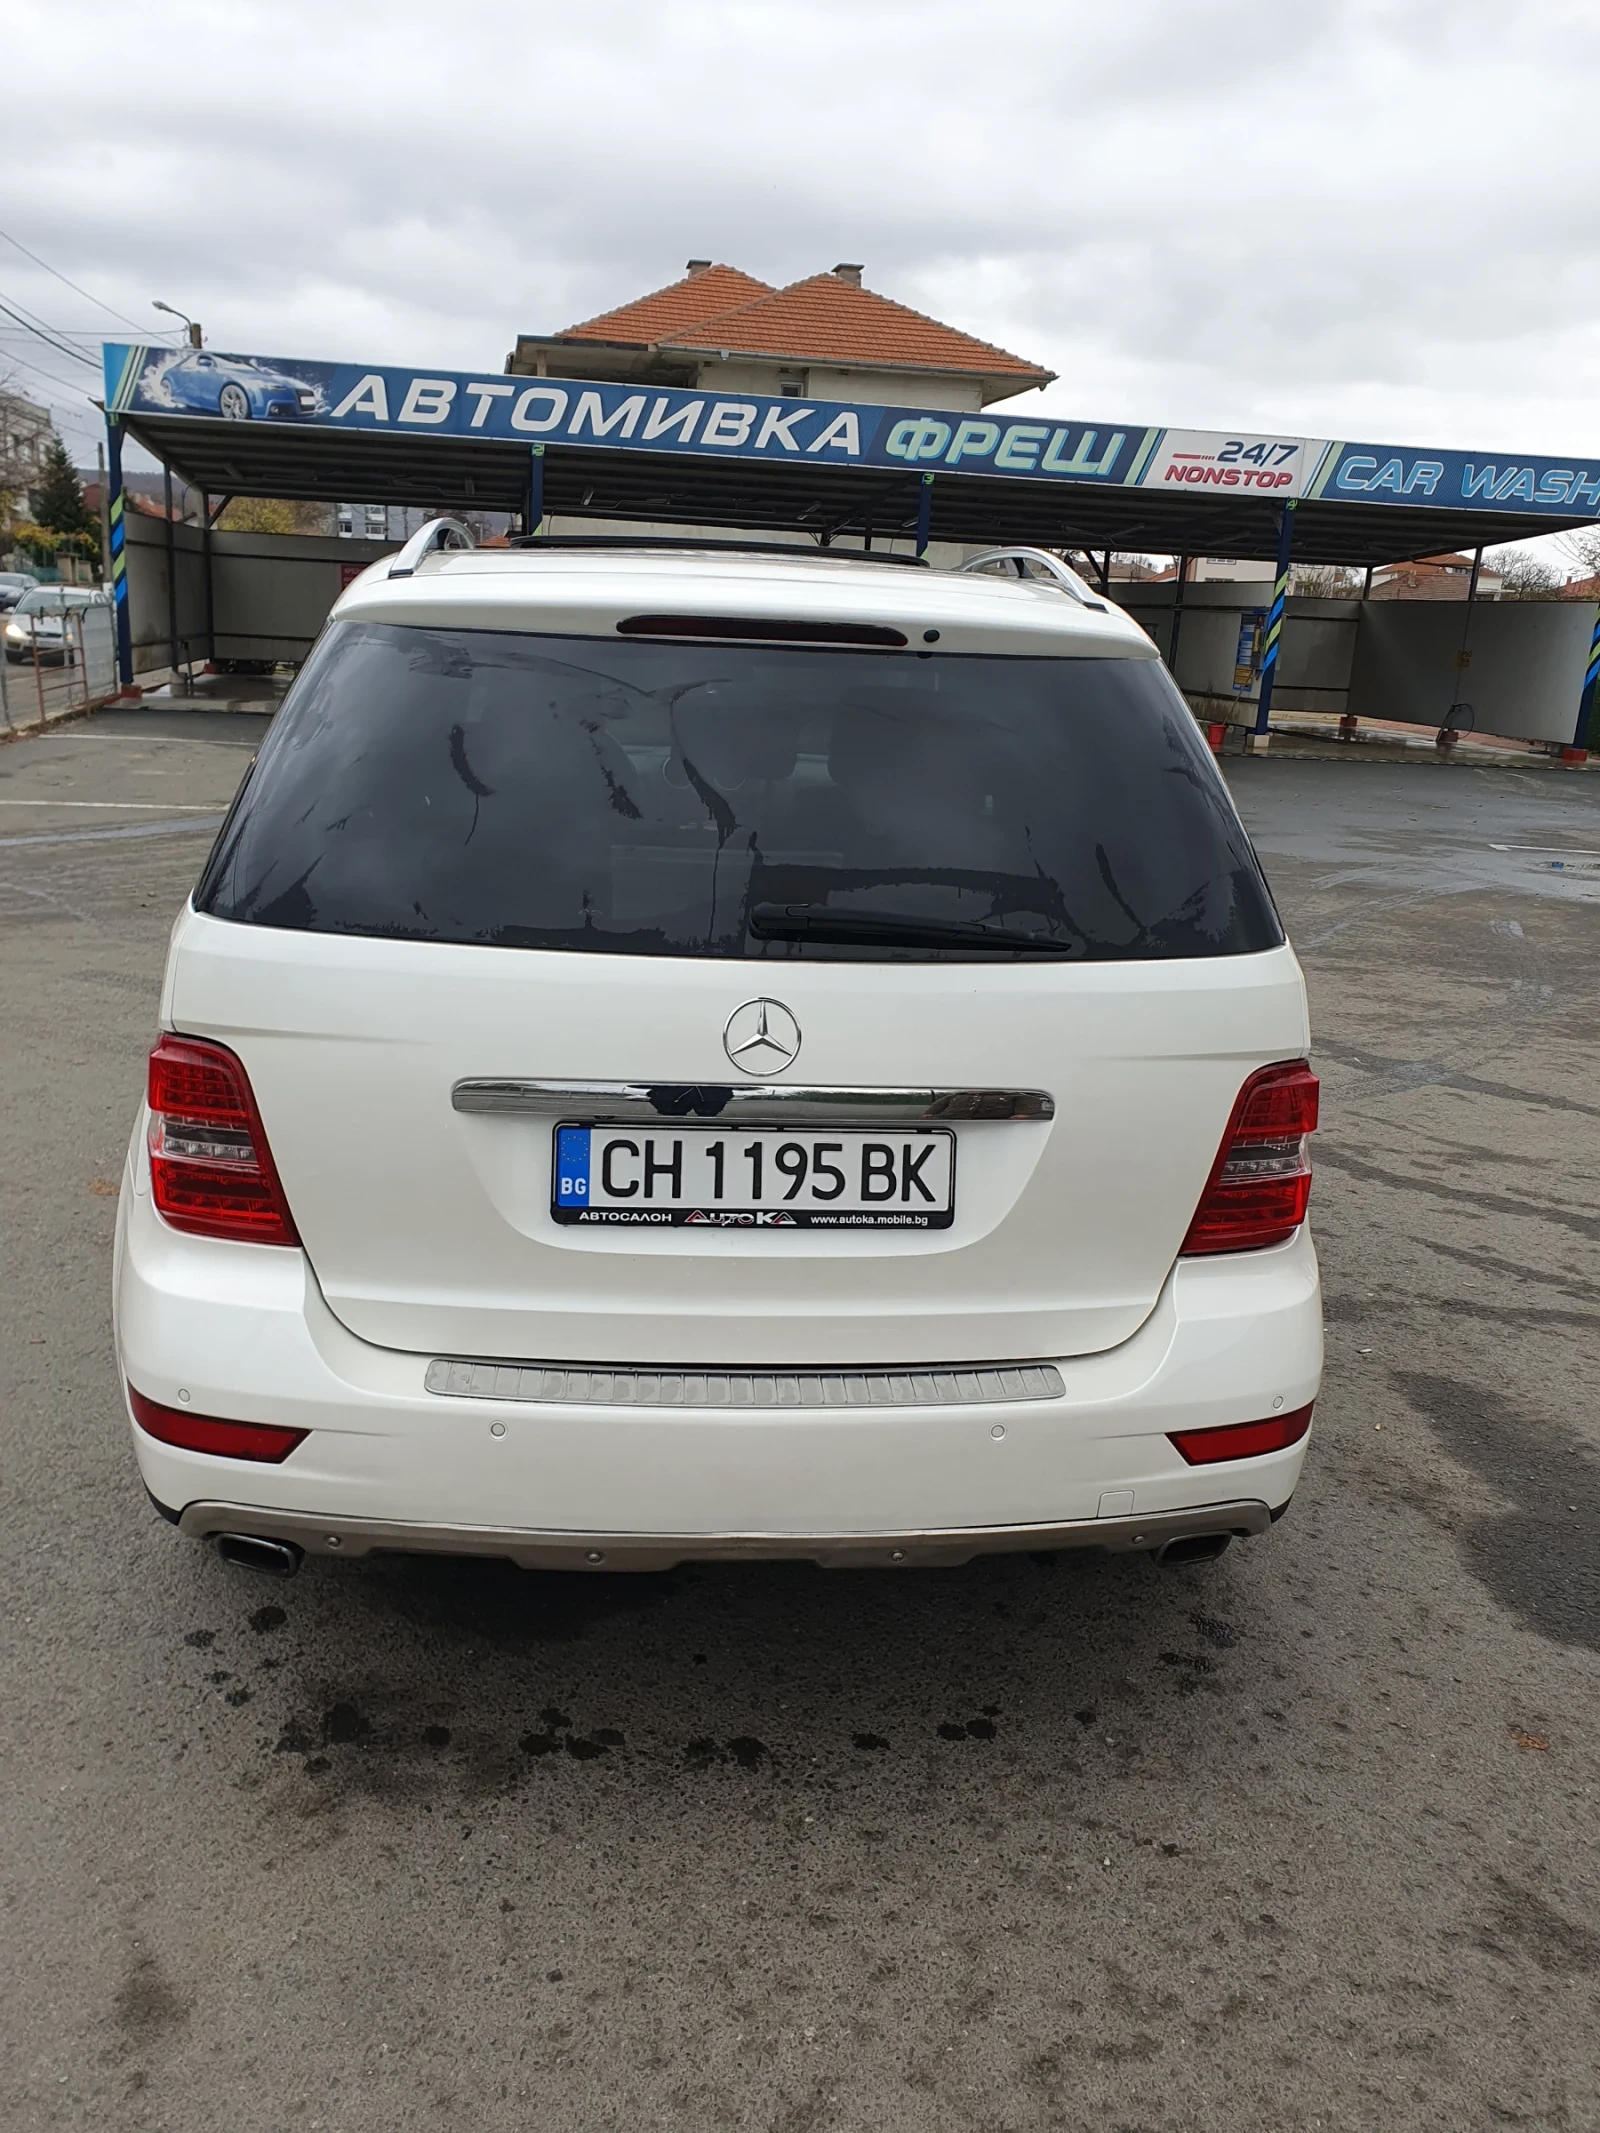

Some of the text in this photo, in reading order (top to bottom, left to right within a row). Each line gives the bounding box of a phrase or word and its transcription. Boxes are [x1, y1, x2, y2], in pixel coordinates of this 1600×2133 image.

[330, 374, 1127, 476] АВТОМИВКА ФРЕШ
[1217, 441, 1299, 468] 24/7
[1164, 465, 1293, 488] NONSTOP
[1336, 456, 1600, 505] CAR WASH
[1286, 498, 1298, 511] 4
[705, 1142, 846, 1201] 1195
[561, 1177, 587, 1195] BG
[579, 1211, 672, 1223] АВТОСАЛОН
[811, 1214, 929, 1226] www.autoka.mobile.bg
